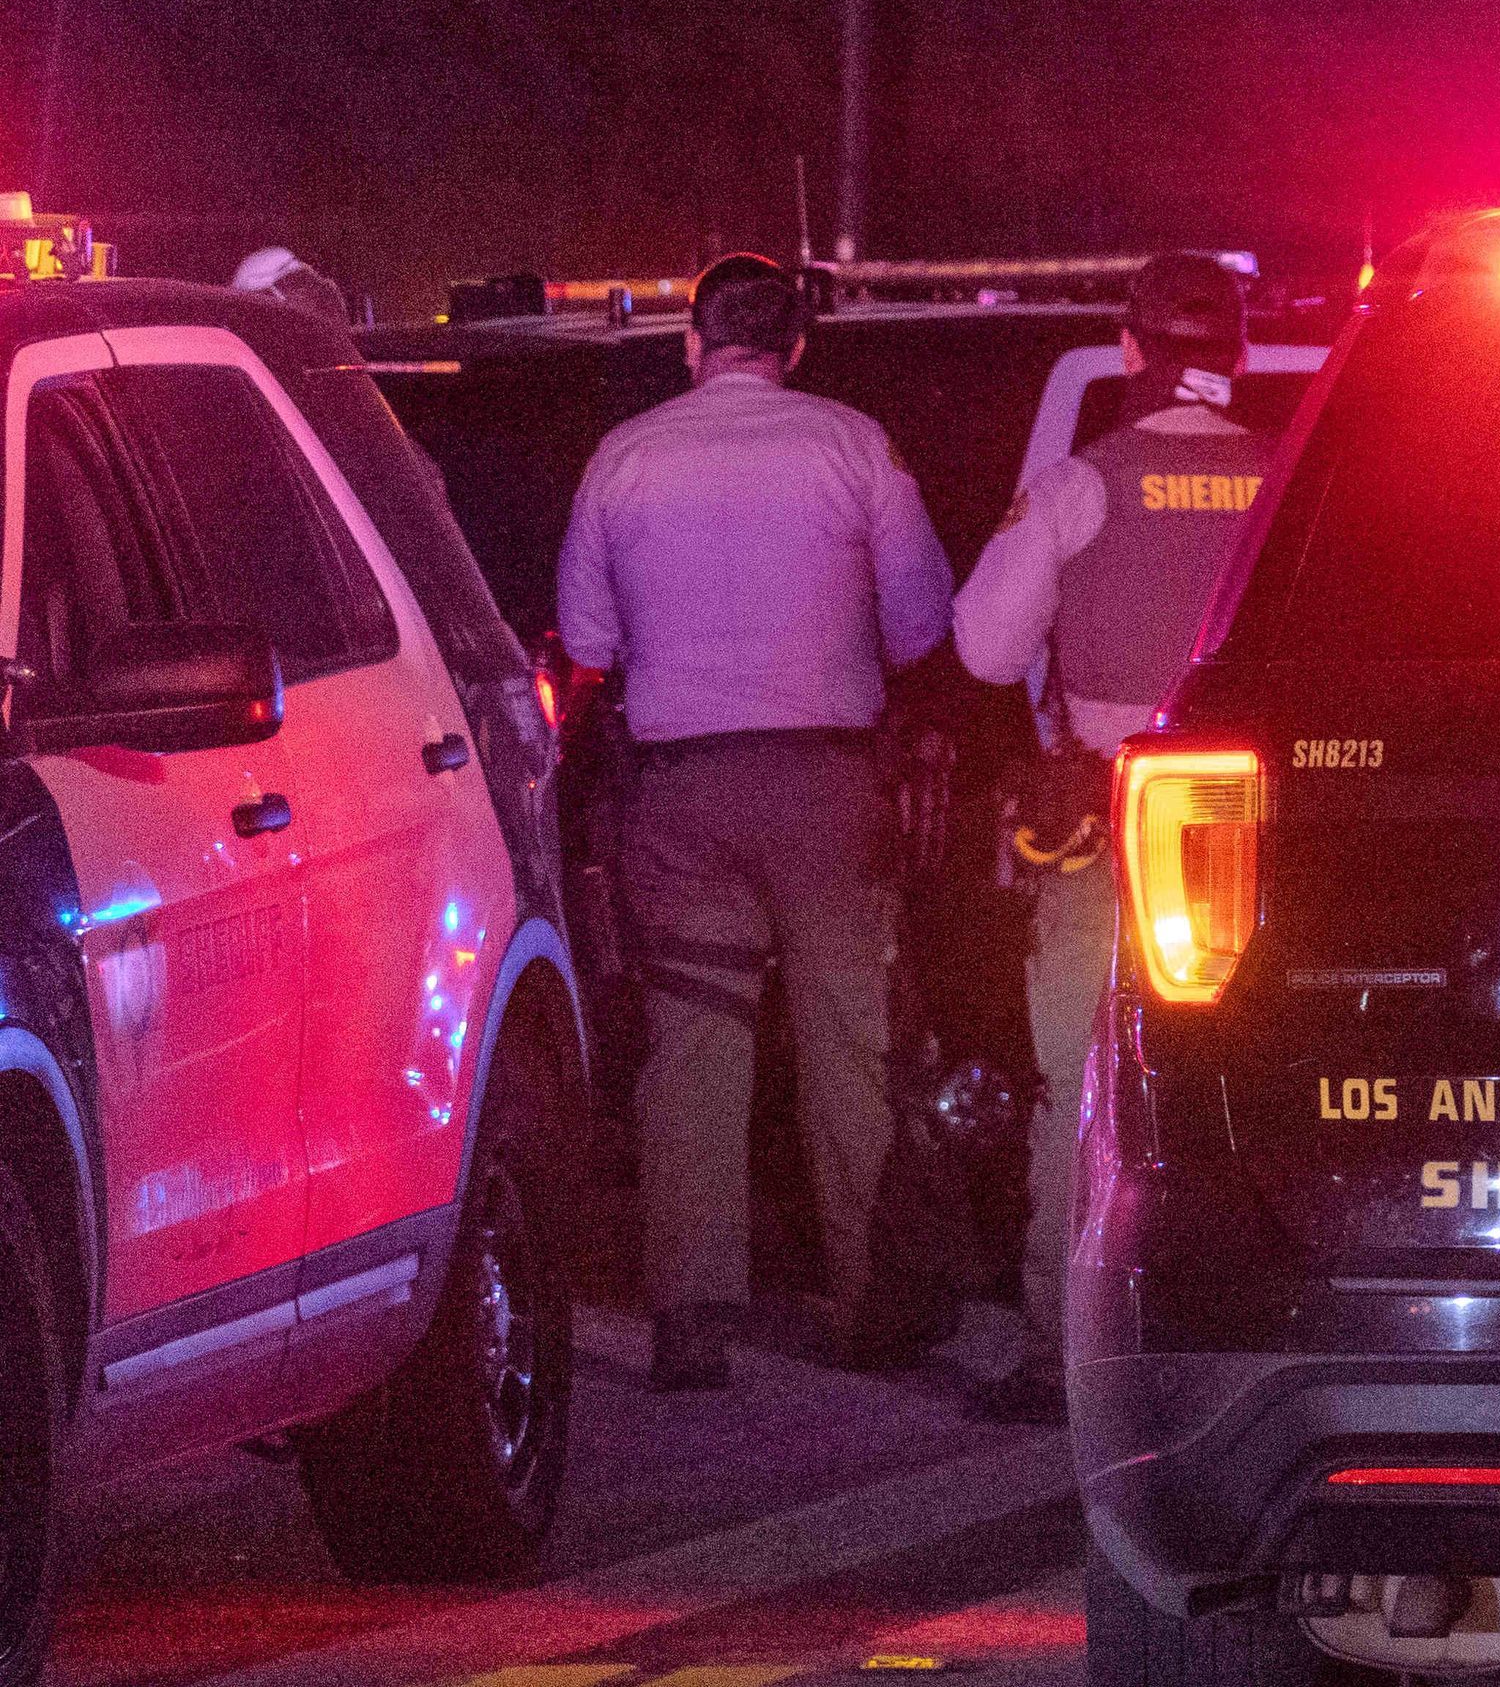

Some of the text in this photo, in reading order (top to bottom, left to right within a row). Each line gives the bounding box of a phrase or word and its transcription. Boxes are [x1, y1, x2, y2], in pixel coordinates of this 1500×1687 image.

[1292, 739, 1384, 768] SH8213
[1342, 973, 1441, 984] INTERCEPTOR
[1320, 1078, 1398, 1121] LOS
